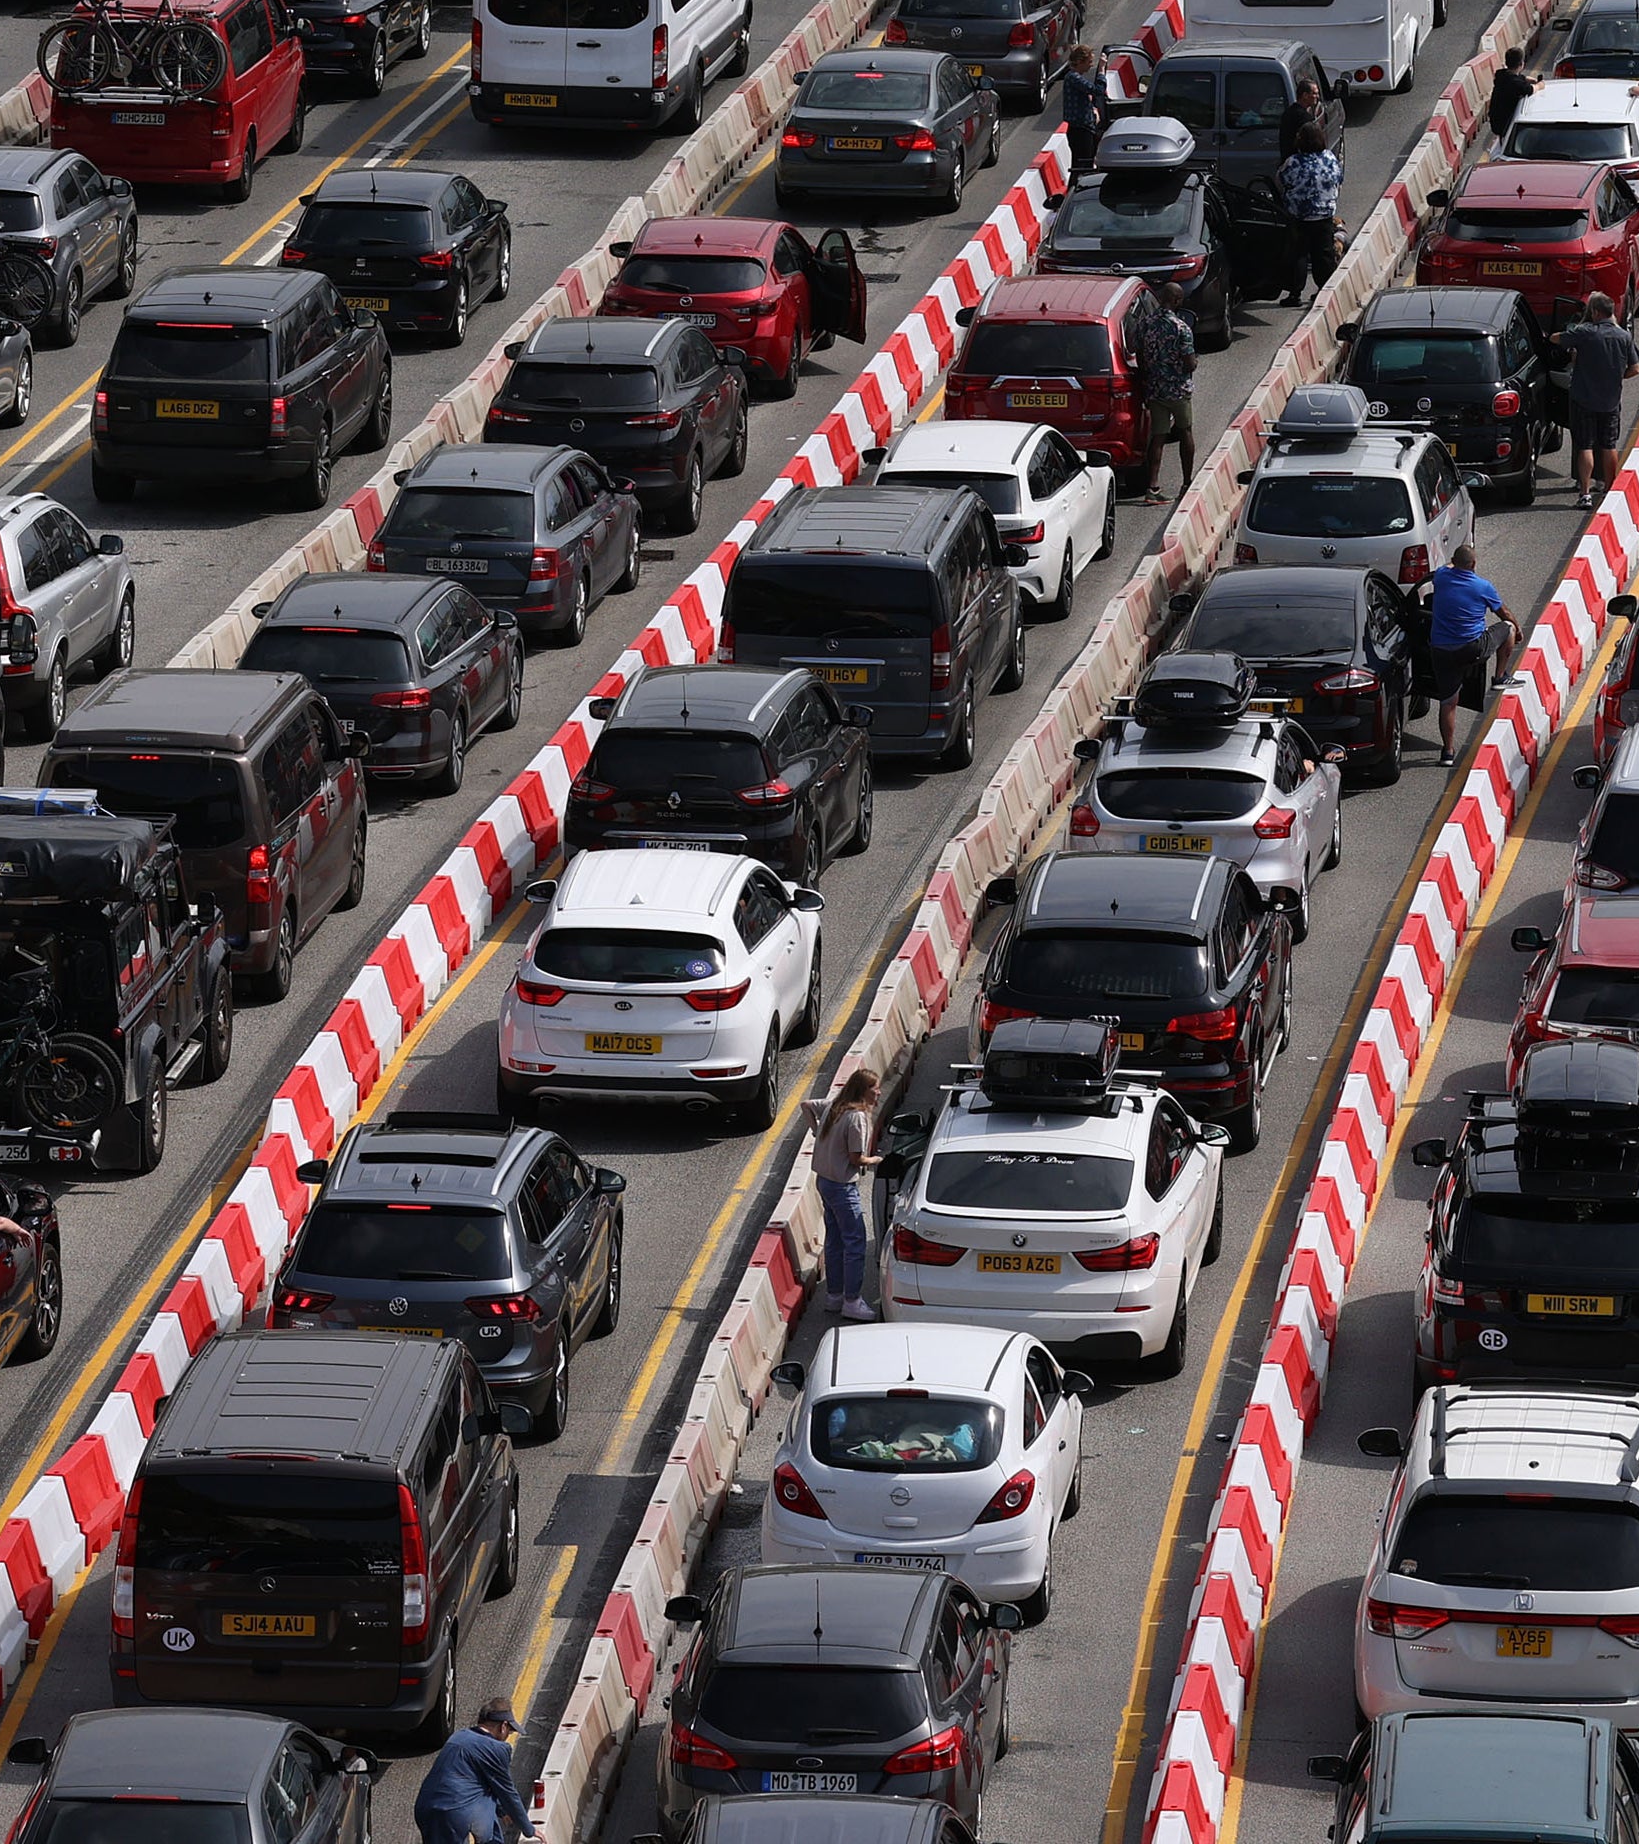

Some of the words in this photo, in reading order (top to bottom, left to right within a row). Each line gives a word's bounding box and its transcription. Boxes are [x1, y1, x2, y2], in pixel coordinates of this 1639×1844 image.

[1370, 402, 1387, 417] GB
[832, 667, 859, 682] HGY
[1178, 837, 1208, 851] LMF
[590, 1035, 622, 1050] MA17
[3, 1145, 28, 1161] 256
[984, 1154, 1017, 1166] Living
[1020, 1155, 1044, 1165] The
[1045, 1155, 1075, 1167] Dream
[982, 1254, 1022, 1271] PO63
[1026, 1254, 1056, 1272] AZG
[1569, 1296, 1599, 1313] SRW
[481, 1326, 502, 1338] UK
[1480, 1331, 1506, 1349] GB
[232, 1616, 268, 1633] SJ14
[270, 1616, 305, 1634] AAU
[165, 1631, 192, 1648] UK
[1508, 1631, 1547, 1644] AY65
[1513, 1644, 1543, 1656] FCJ
[769, 1772, 792, 1791] MO
[800, 1772, 816, 1790] TB
[820, 1772, 856, 1791] 1969
